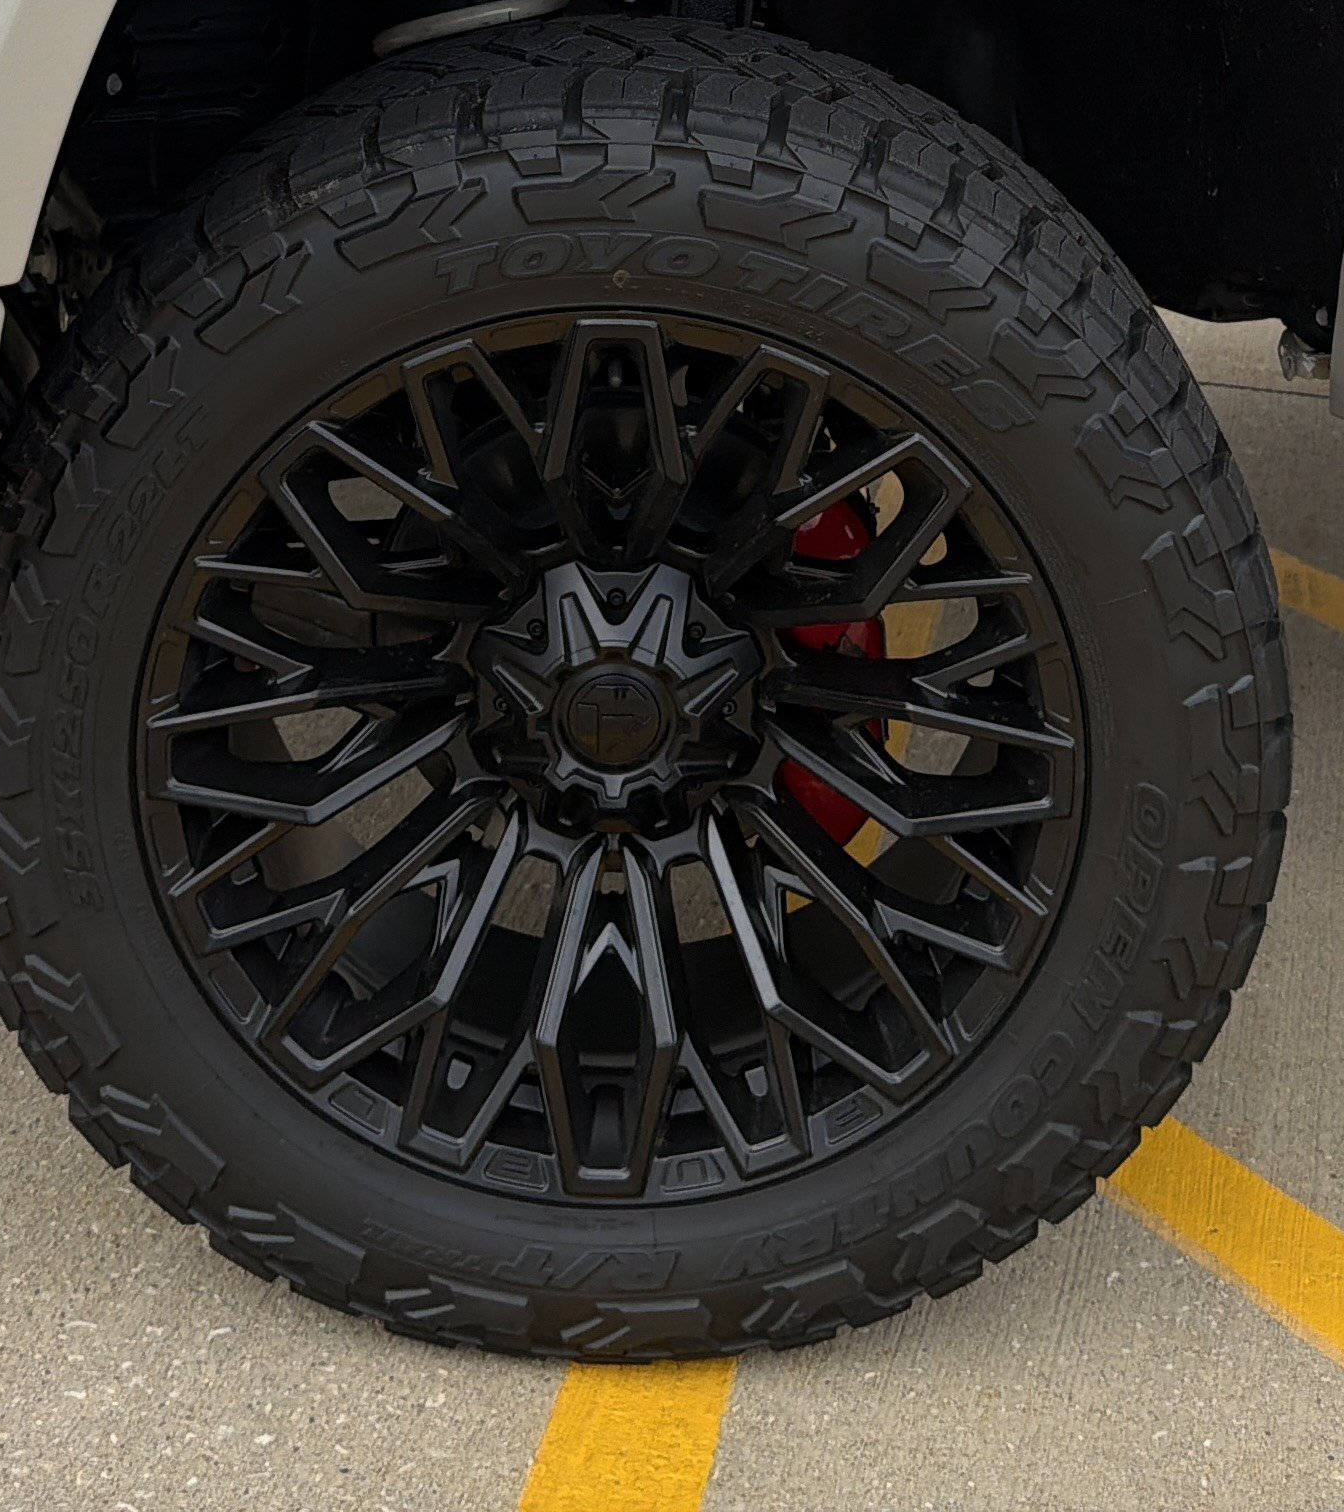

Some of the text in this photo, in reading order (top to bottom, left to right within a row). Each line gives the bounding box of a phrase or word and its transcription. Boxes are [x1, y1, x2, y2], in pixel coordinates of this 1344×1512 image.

[433, 230, 723, 294] TOYO
[737, 249, 1038, 434] TIRES
[1060, 780, 1173, 1033] OPEN
[712, 1030, 1078, 1281] COUNTRY
